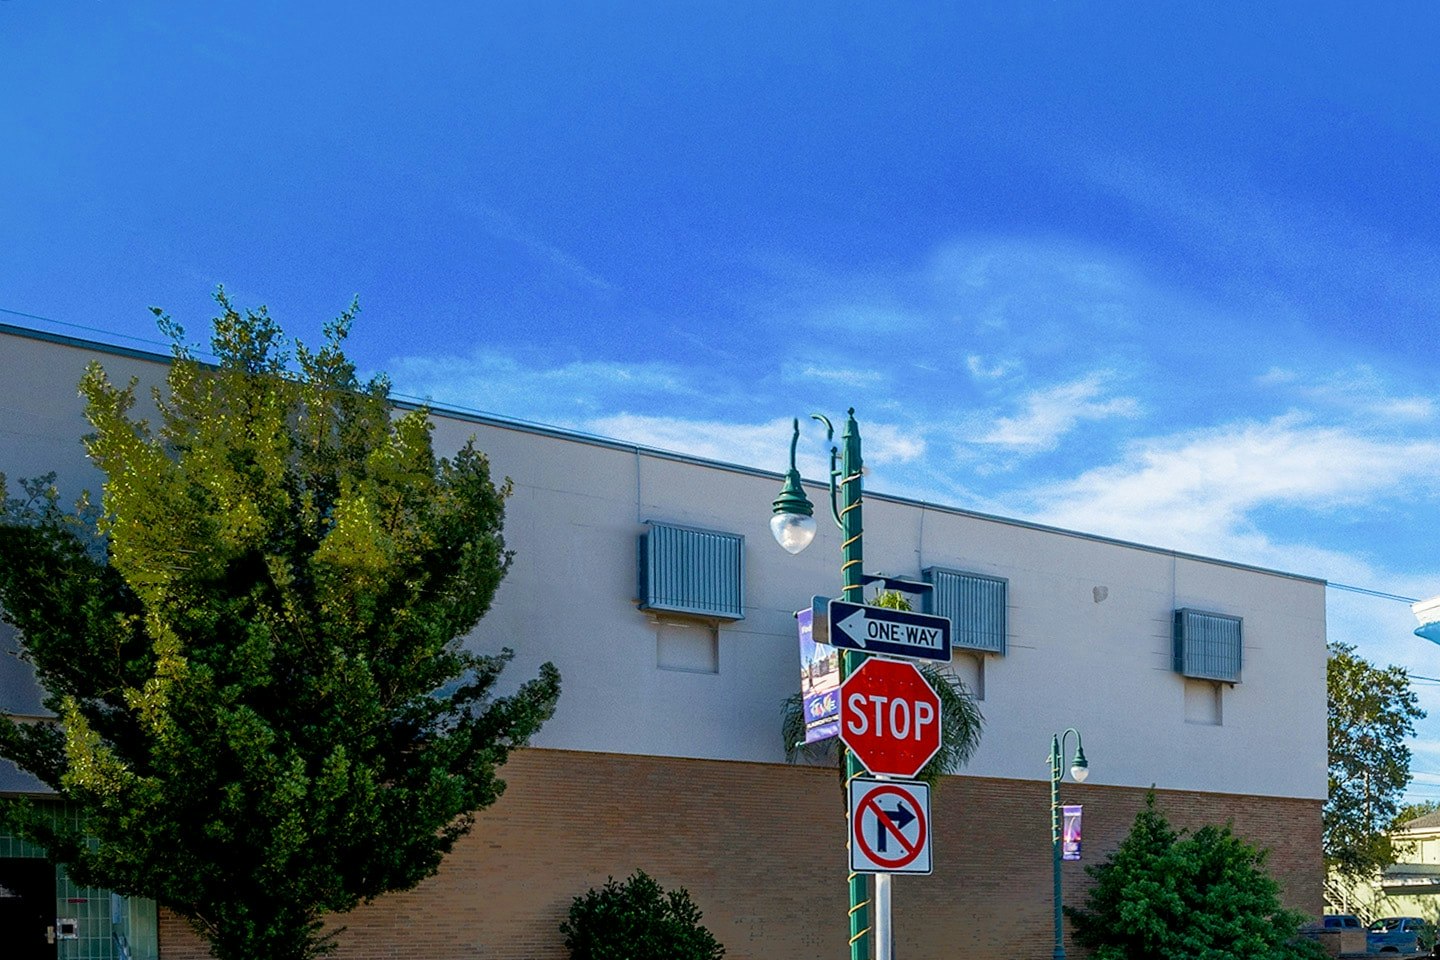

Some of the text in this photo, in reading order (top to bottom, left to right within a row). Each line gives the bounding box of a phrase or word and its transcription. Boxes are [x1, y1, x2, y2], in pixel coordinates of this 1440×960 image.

[867, 620, 939, 647] ONE WAY
[848, 693, 934, 741] STOP
